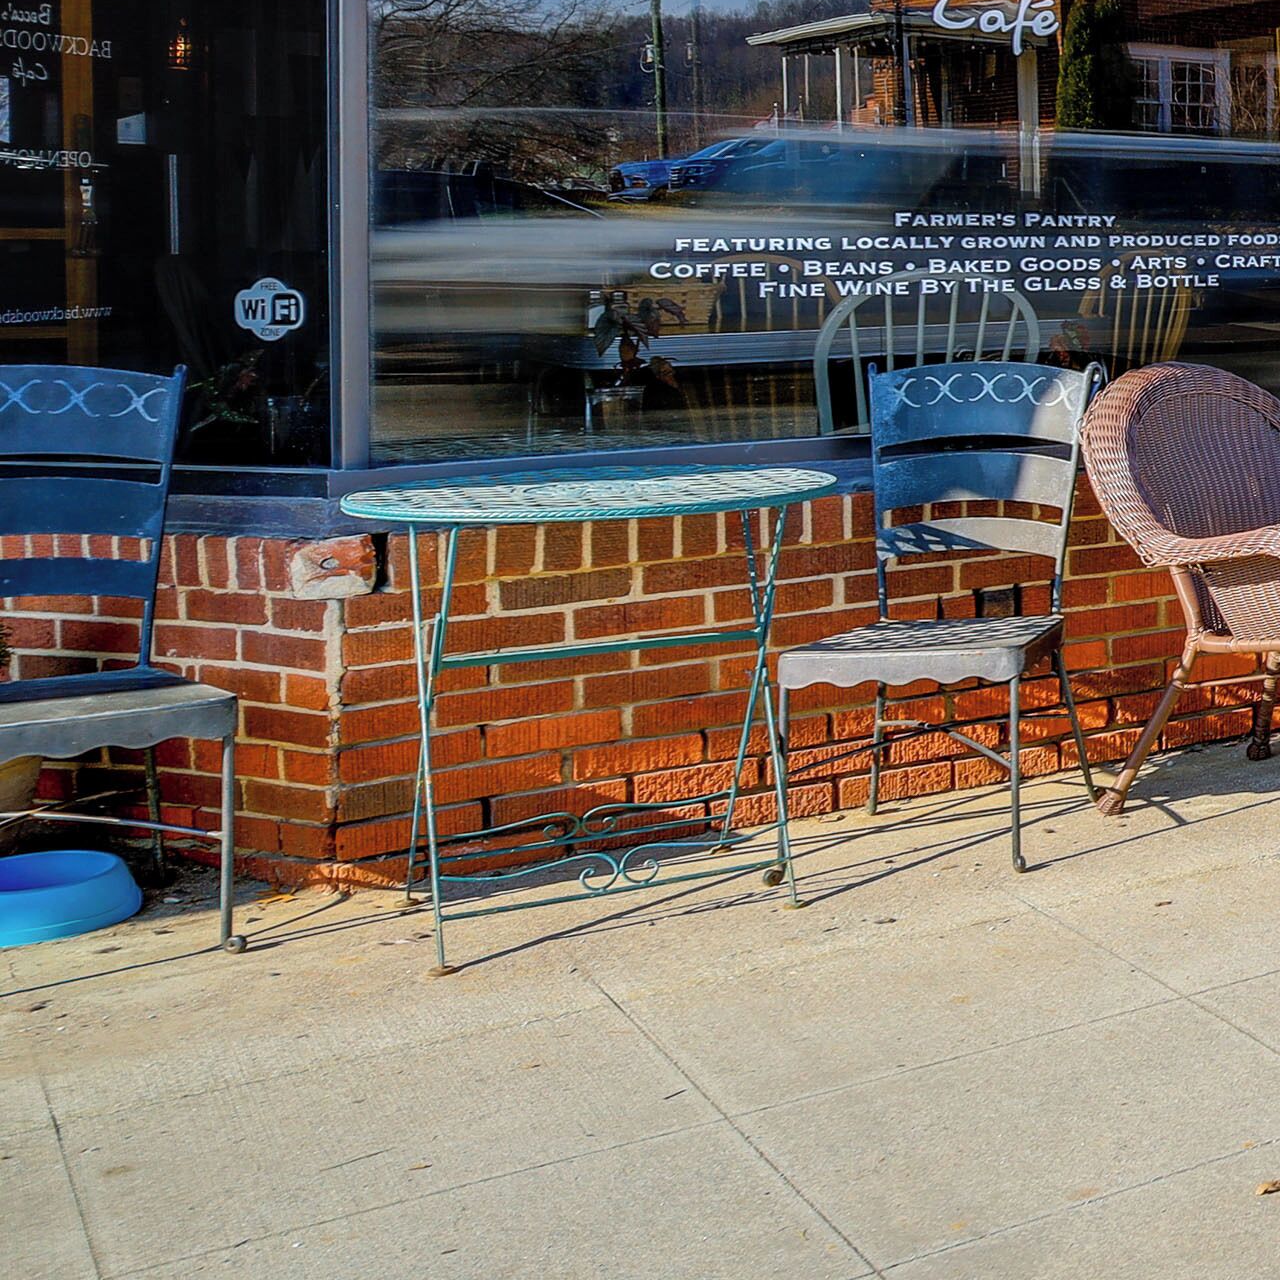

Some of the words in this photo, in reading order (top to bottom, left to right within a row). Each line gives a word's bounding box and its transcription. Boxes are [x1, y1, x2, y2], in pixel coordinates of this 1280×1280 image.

[894, 212, 1016, 227] FARMER'S
[1024, 213, 1116, 228] PANTRY
[675, 237, 832, 252] FEATURING
[841, 236, 954, 250] LOCALLY
[960, 235, 1046, 249] GROWN
[1054, 235, 1101, 248] AND
[1108, 234, 1221, 248] PRODUCED
[649, 261, 766, 279] COFFEE
[803, 260, 894, 276] BEANS
[928, 258, 1012, 274] BAKED
[1019, 256, 1101, 272] GOODS
[1130, 255, 1188, 270] ARTS
[260, 281, 278, 291] FREE
[758, 281, 826, 298] FINE
[834, 280, 910, 296] WINE
[920, 279, 957, 294] BY
[964, 277, 1016, 293] THE
[1023, 276, 1101, 292] GLASS
[1109, 274, 1127, 289] &
[1136, 273, 1220, 289] BOTTLE
[260, 327, 280, 337] ZONE
